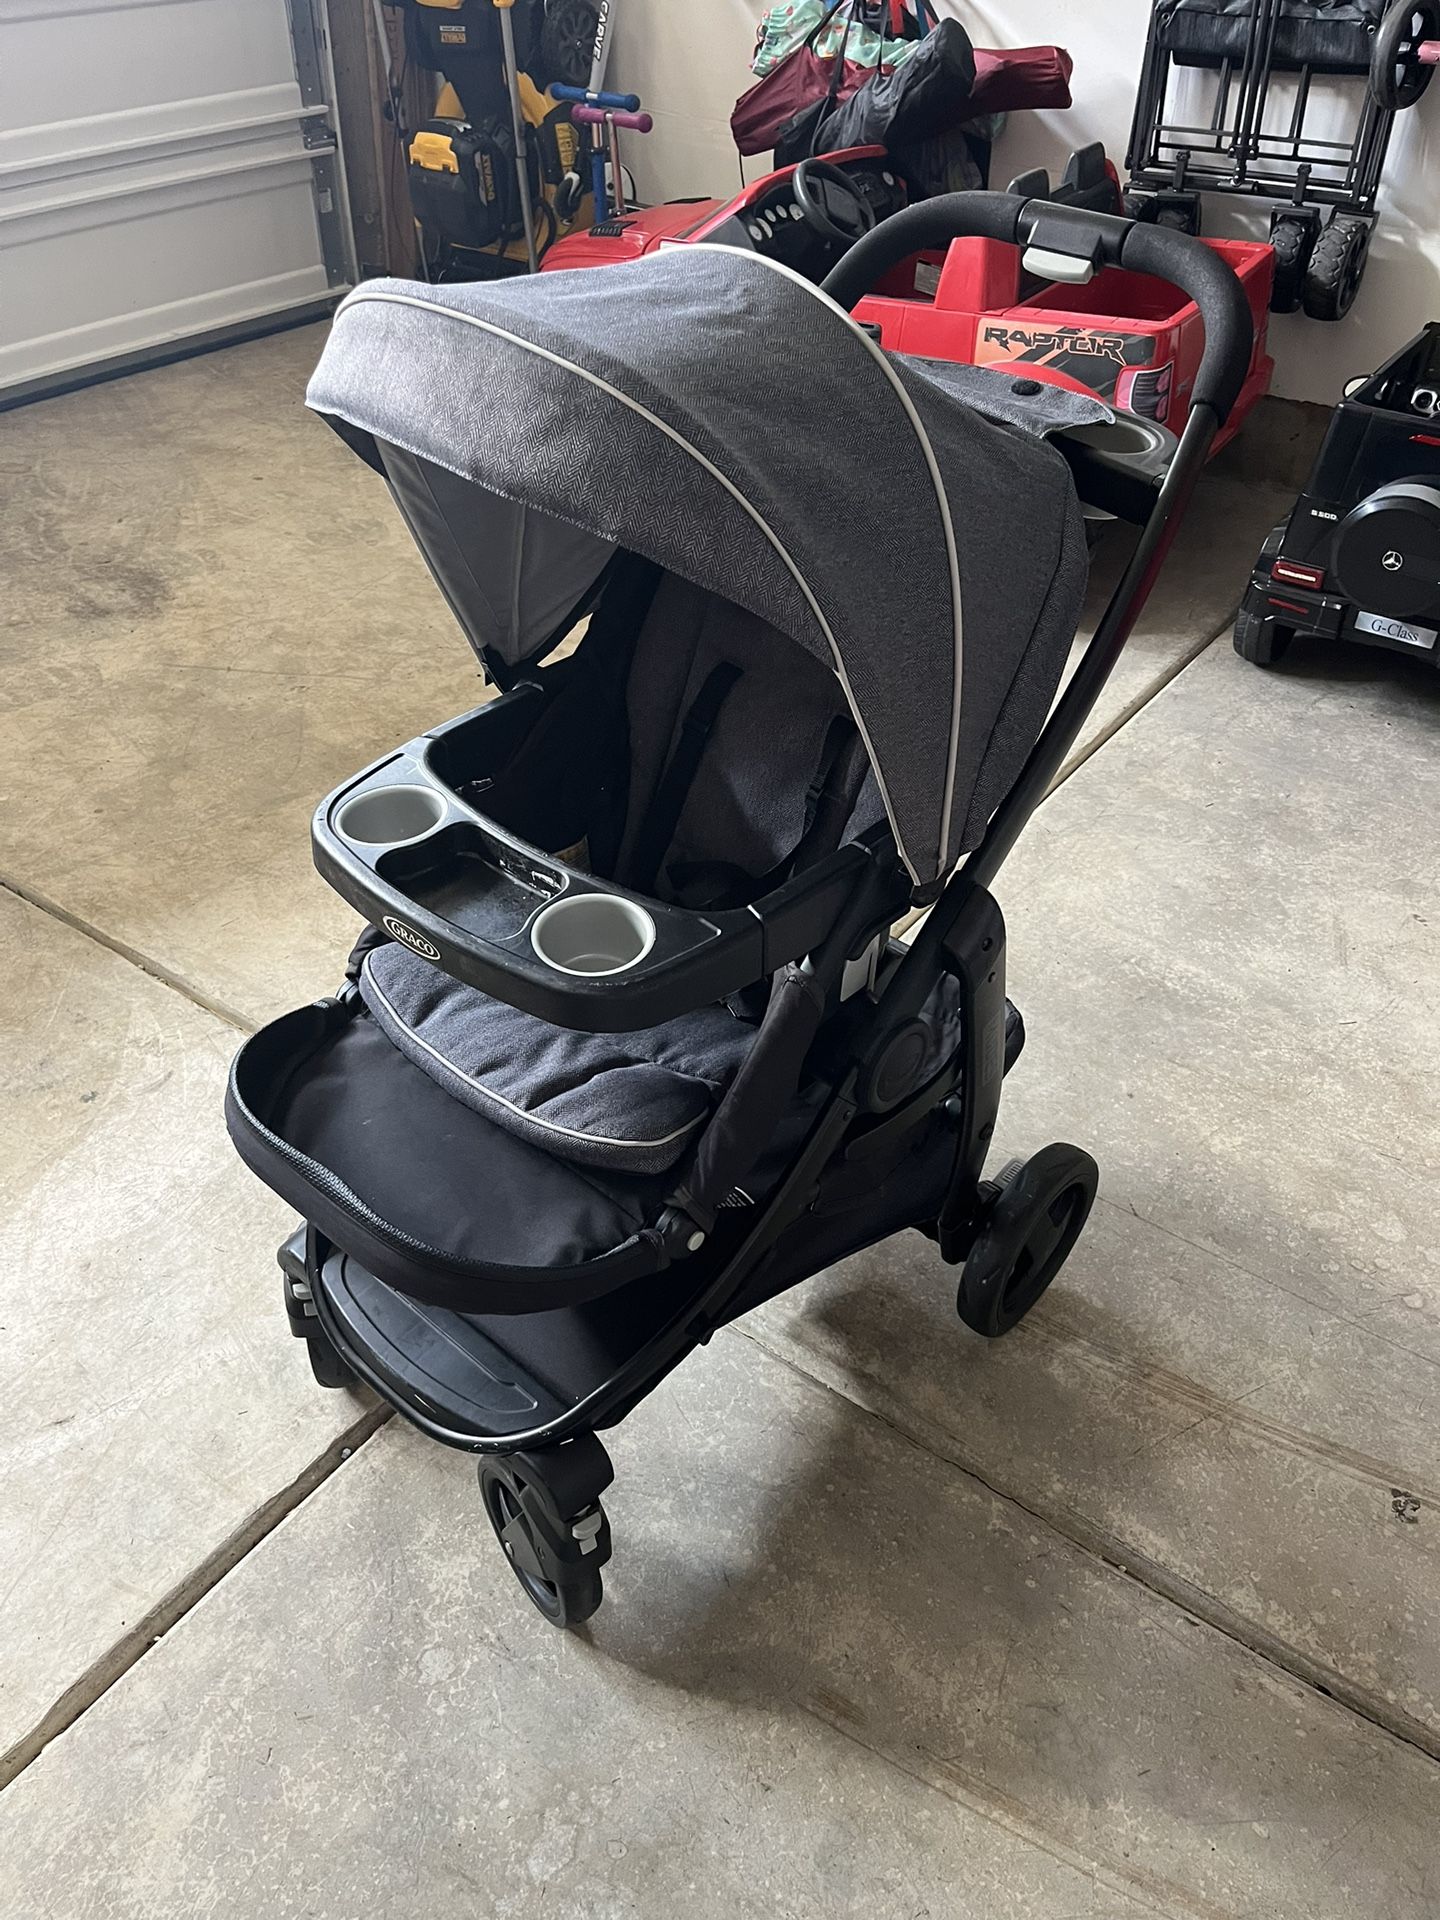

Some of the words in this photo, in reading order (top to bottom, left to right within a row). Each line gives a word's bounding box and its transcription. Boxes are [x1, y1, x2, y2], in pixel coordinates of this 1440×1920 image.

[593, 0, 609, 61] CARVE
[983, 326, 1127, 367] RAPTOR
[1371, 619, 1419, 642] G-Class
[390, 920, 435, 956] GRACO
